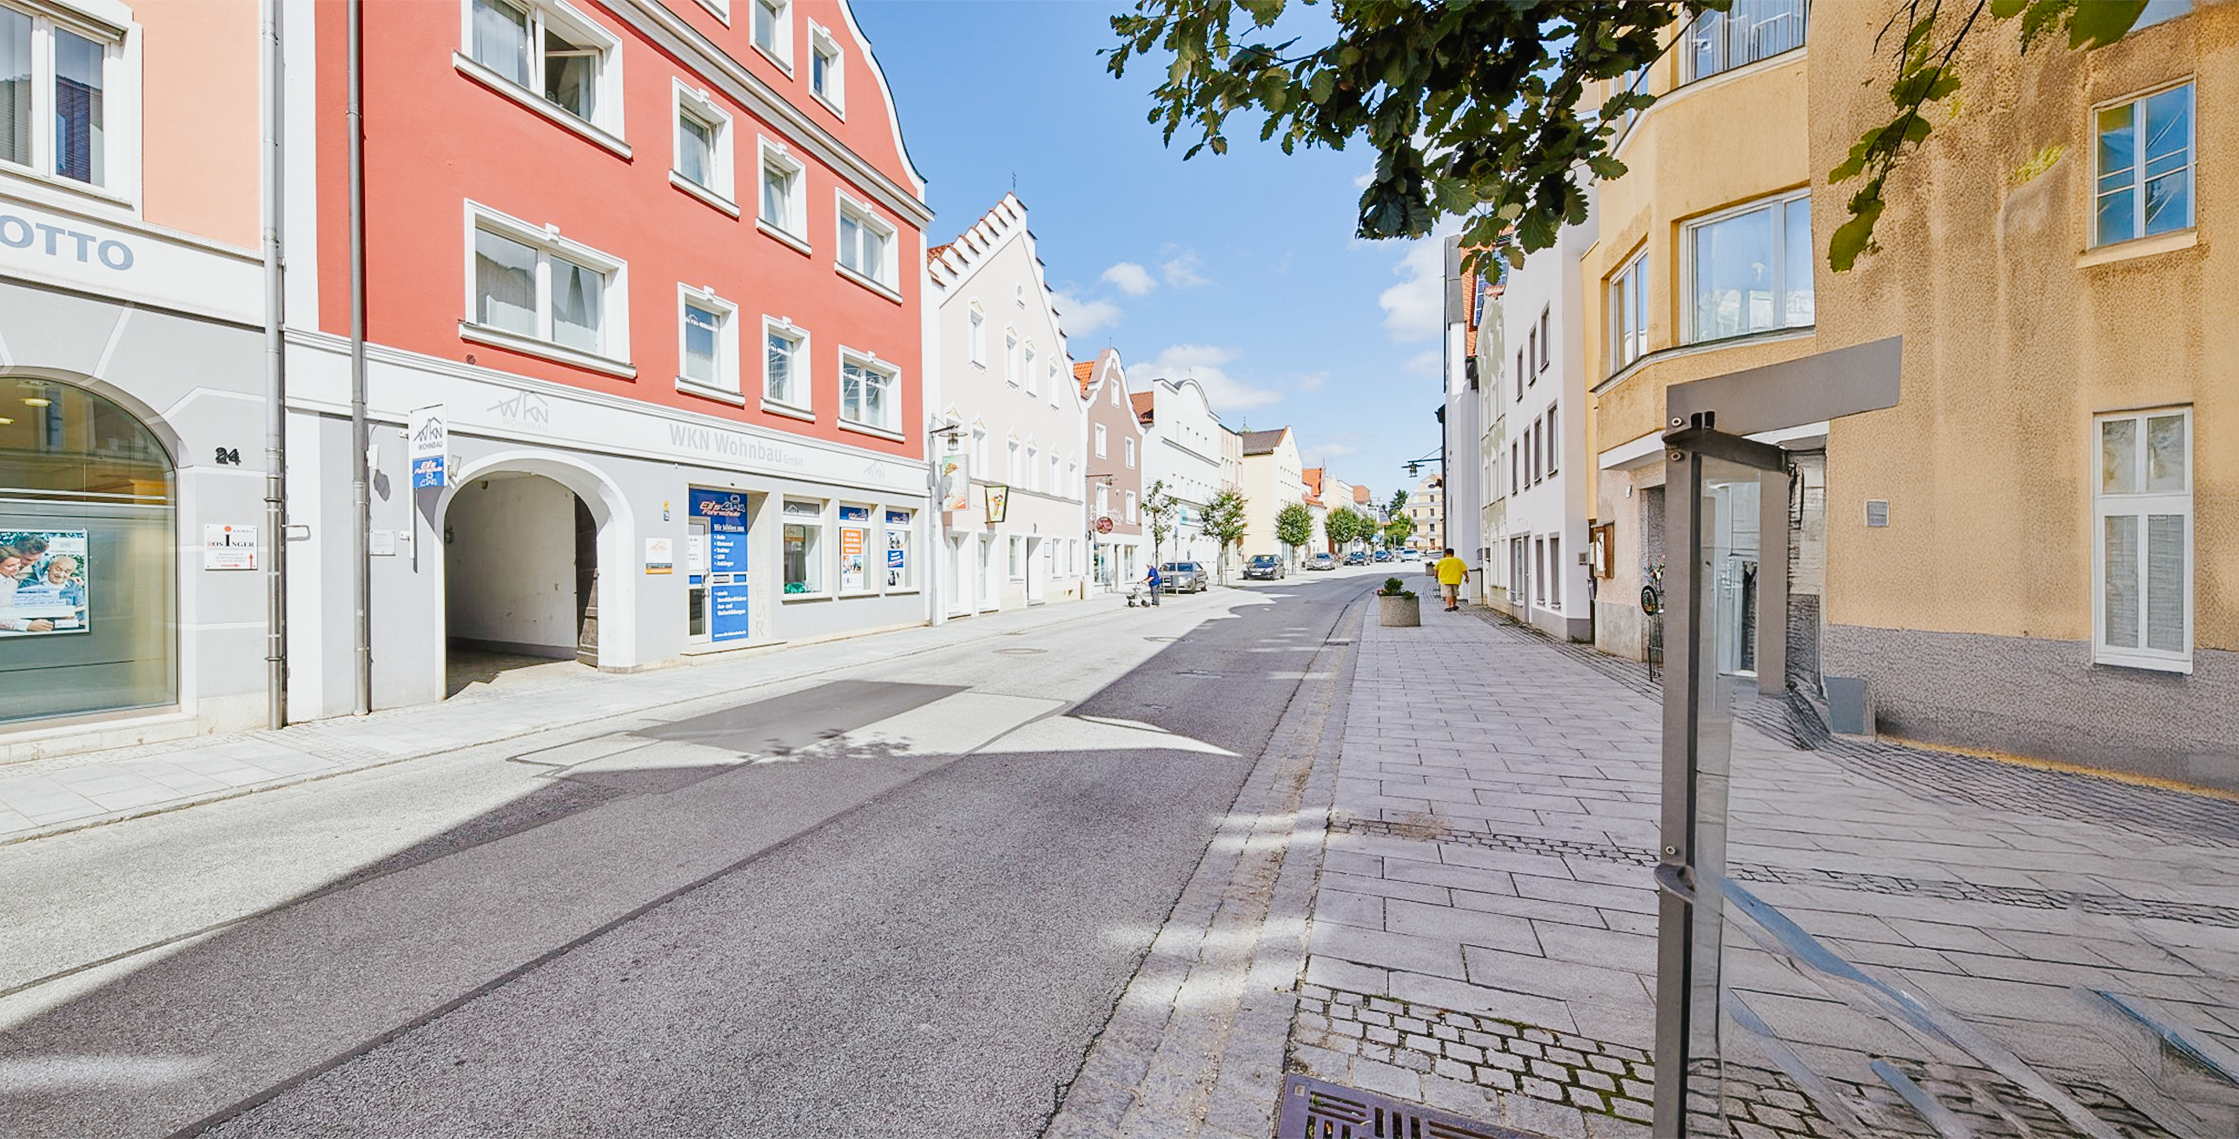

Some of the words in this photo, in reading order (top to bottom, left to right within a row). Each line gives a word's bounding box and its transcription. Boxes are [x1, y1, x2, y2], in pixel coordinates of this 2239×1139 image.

[0, 215, 134, 271] OTTO
[215, 447, 241, 466] 24
[669, 424, 709, 451] WKN
[714, 432, 782, 462] Wohnbau
[783, 454, 804, 467] GmbH
